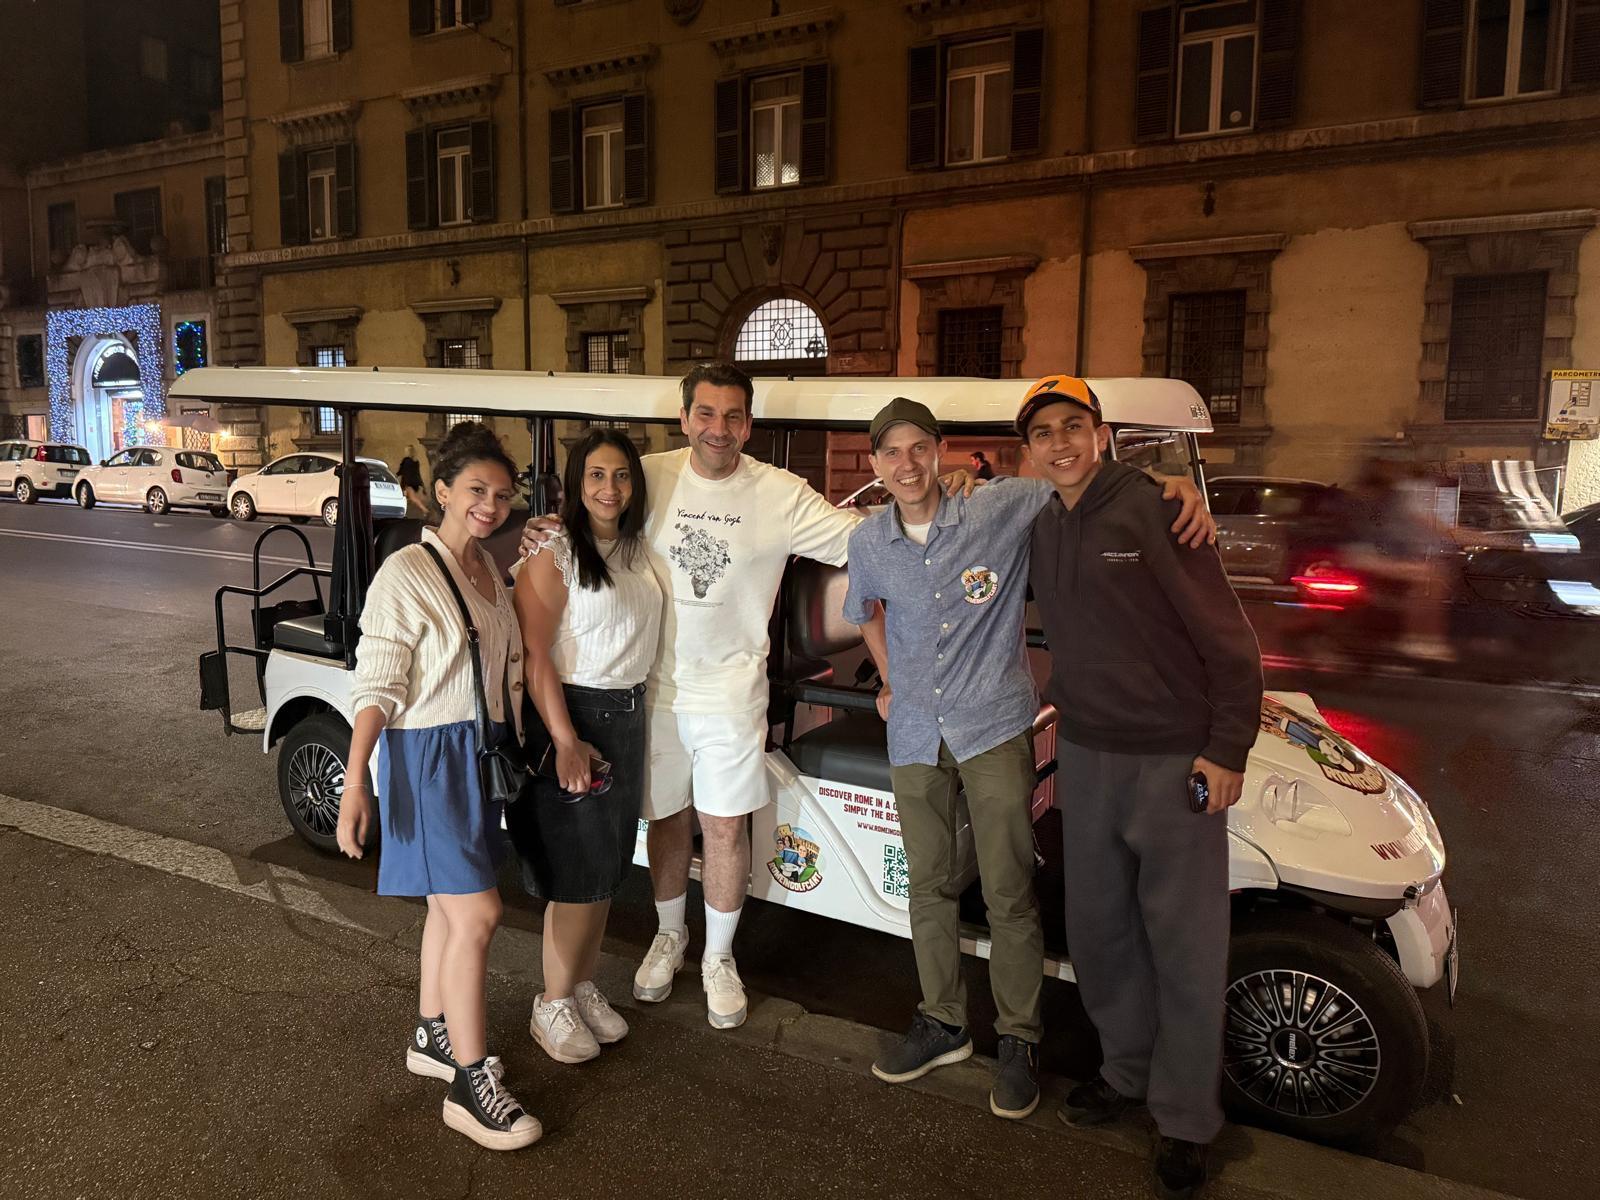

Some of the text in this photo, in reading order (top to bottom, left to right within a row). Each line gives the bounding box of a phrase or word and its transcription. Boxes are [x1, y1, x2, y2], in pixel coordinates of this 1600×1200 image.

[677, 508, 742, 527] Vincent van Gogh
[819, 787, 852, 802] DISCOVER
[854, 793, 874, 806] ROME
[875, 797, 883, 808] IN
[885, 800, 891, 810] A
[844, 804, 901, 823] SIMPLY THE BES
[1288, 1032, 1298, 1061] melex
